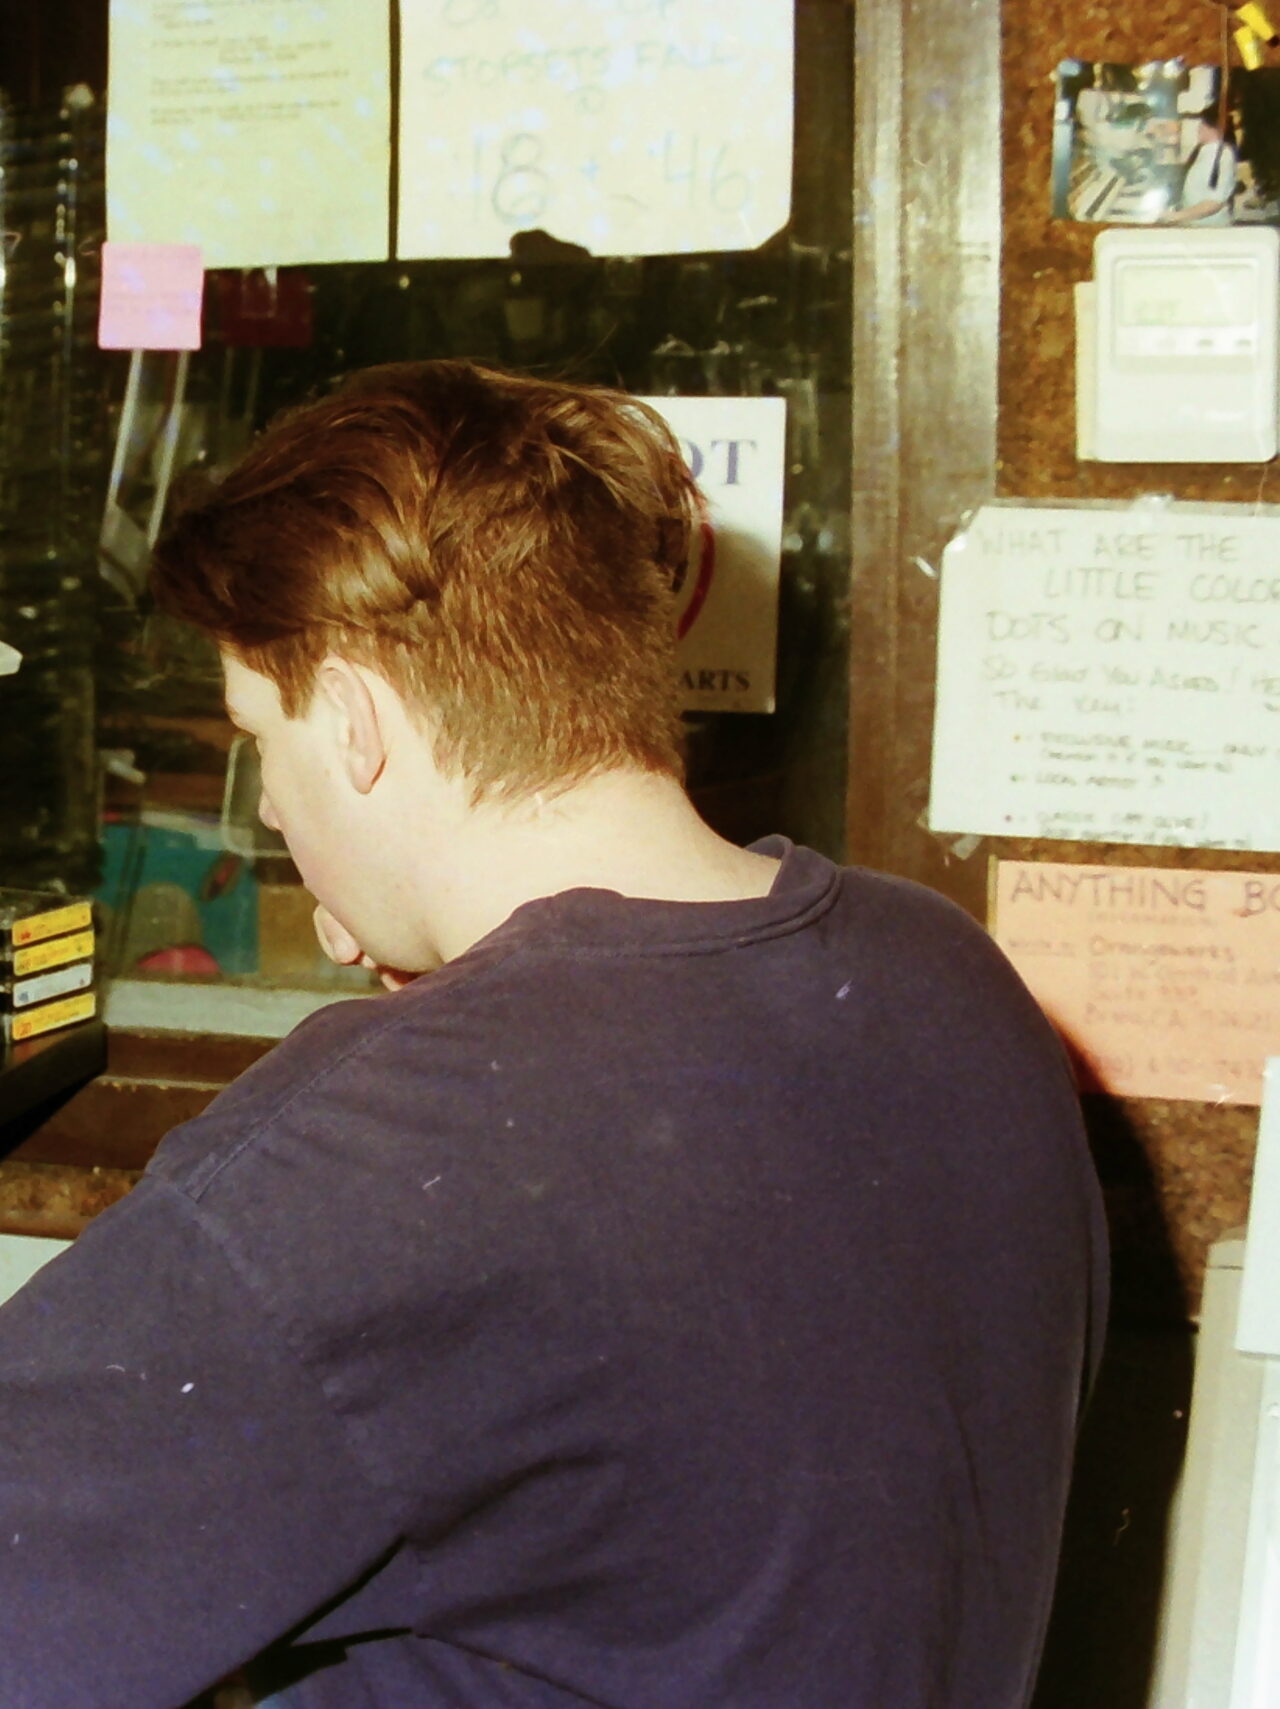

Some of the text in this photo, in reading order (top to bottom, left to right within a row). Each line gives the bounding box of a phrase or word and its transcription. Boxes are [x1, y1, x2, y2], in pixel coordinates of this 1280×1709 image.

[634, 40, 738, 70] FALL
[976, 527, 1240, 562] WHAT ARE THE
[1043, 566, 1161, 601] LITTLE
[985, 609, 1265, 650] DOTS ON MUSIC
[1009, 868, 1207, 911] ANYTHING
